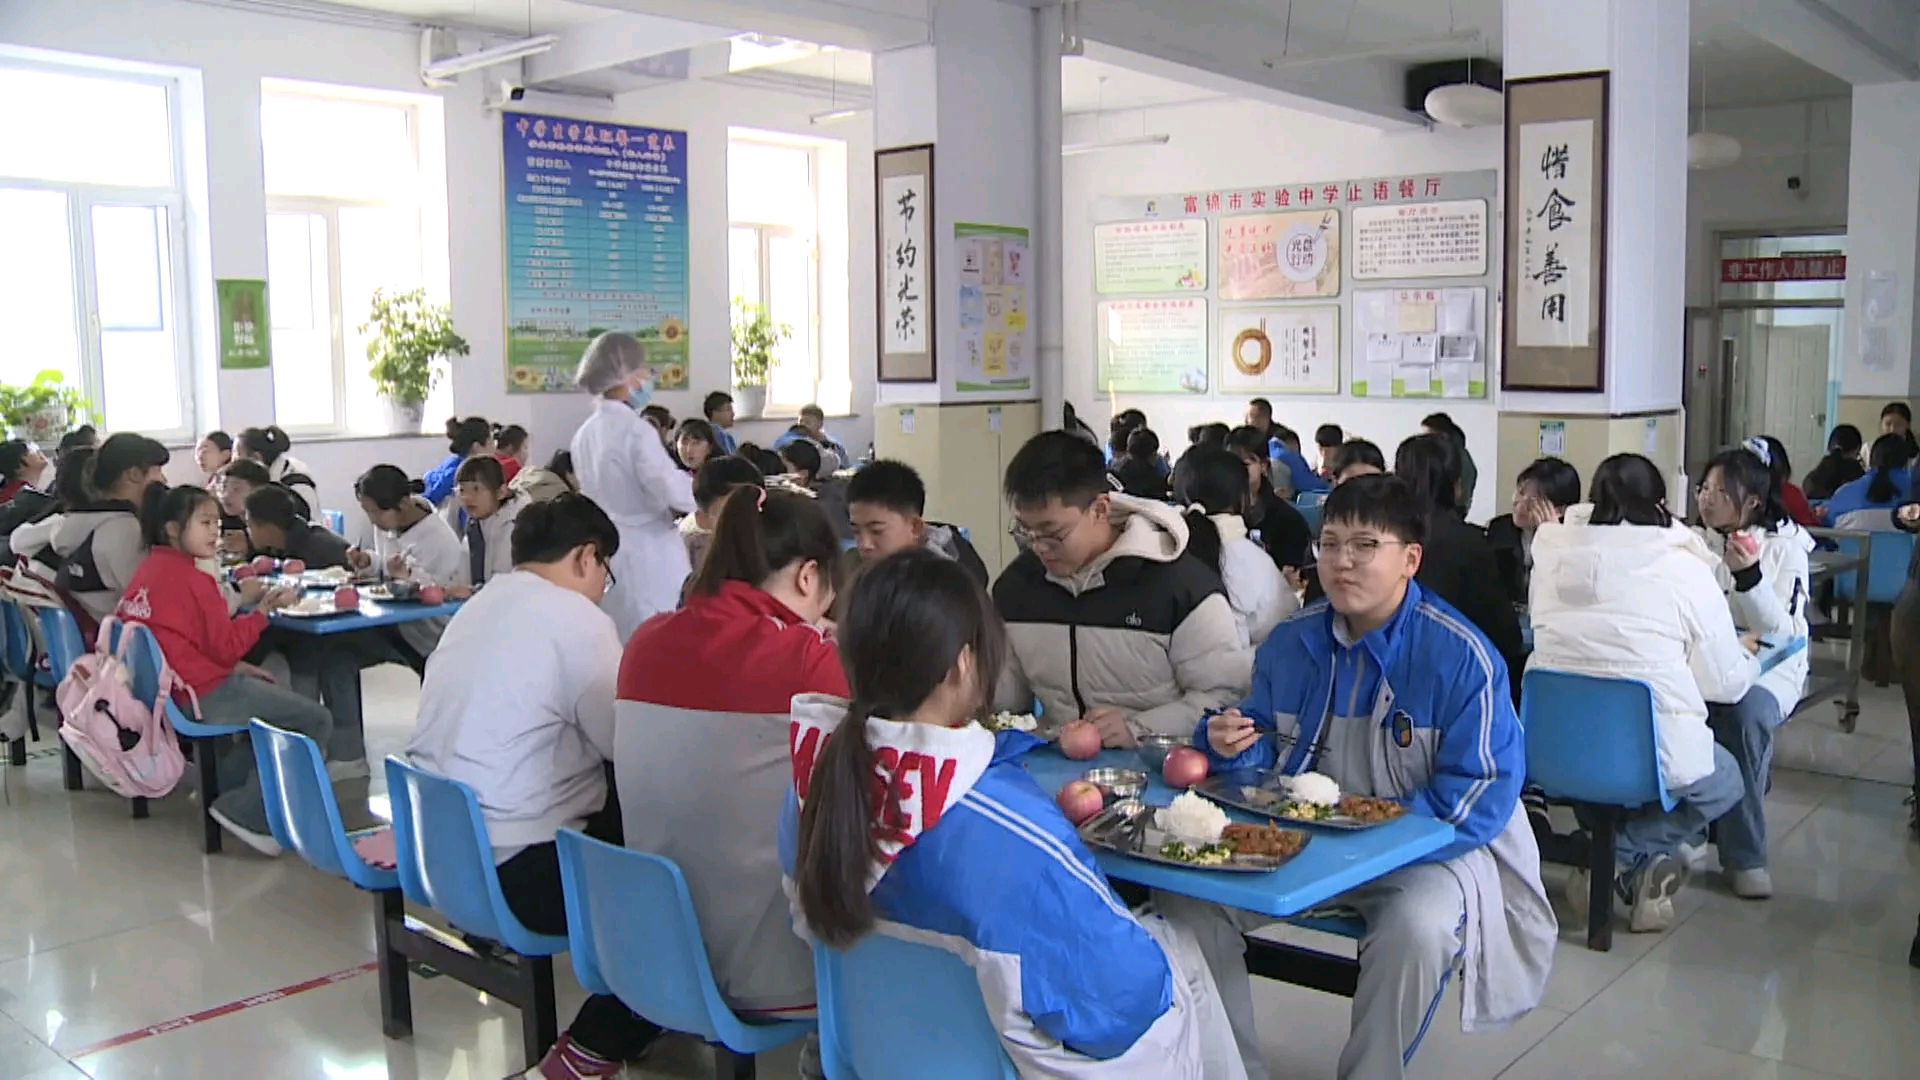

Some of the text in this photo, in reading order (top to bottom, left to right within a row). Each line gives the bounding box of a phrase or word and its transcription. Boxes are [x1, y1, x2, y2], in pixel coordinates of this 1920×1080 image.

[895, 188, 918, 341] 节约光荣
[1183, 178, 1441, 215] 富锦市实验中学止语餐厅
[1532, 143, 1576, 323] 惜食善用
